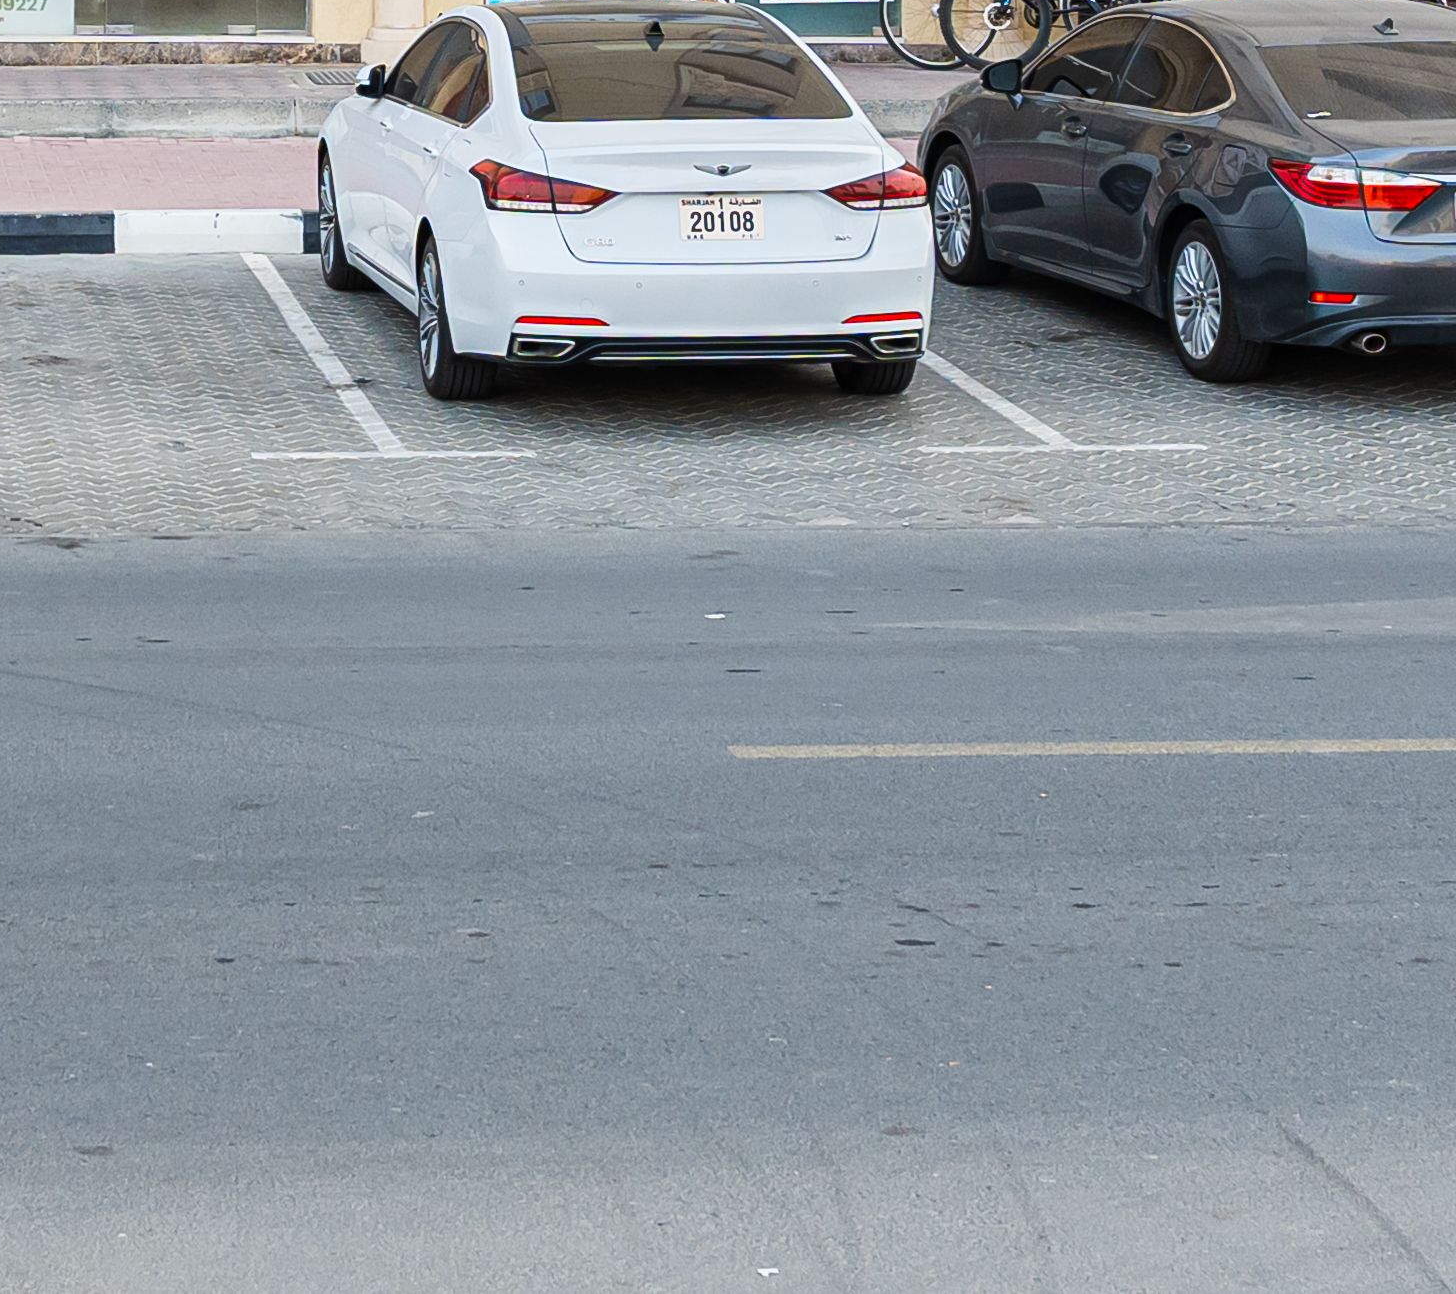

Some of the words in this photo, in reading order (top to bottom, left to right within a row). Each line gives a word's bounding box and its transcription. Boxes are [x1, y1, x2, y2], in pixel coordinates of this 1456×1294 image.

[718, 197, 723, 209] 1
[729, 197, 762, 207] الشارقة
[690, 210, 755, 232] 20108
